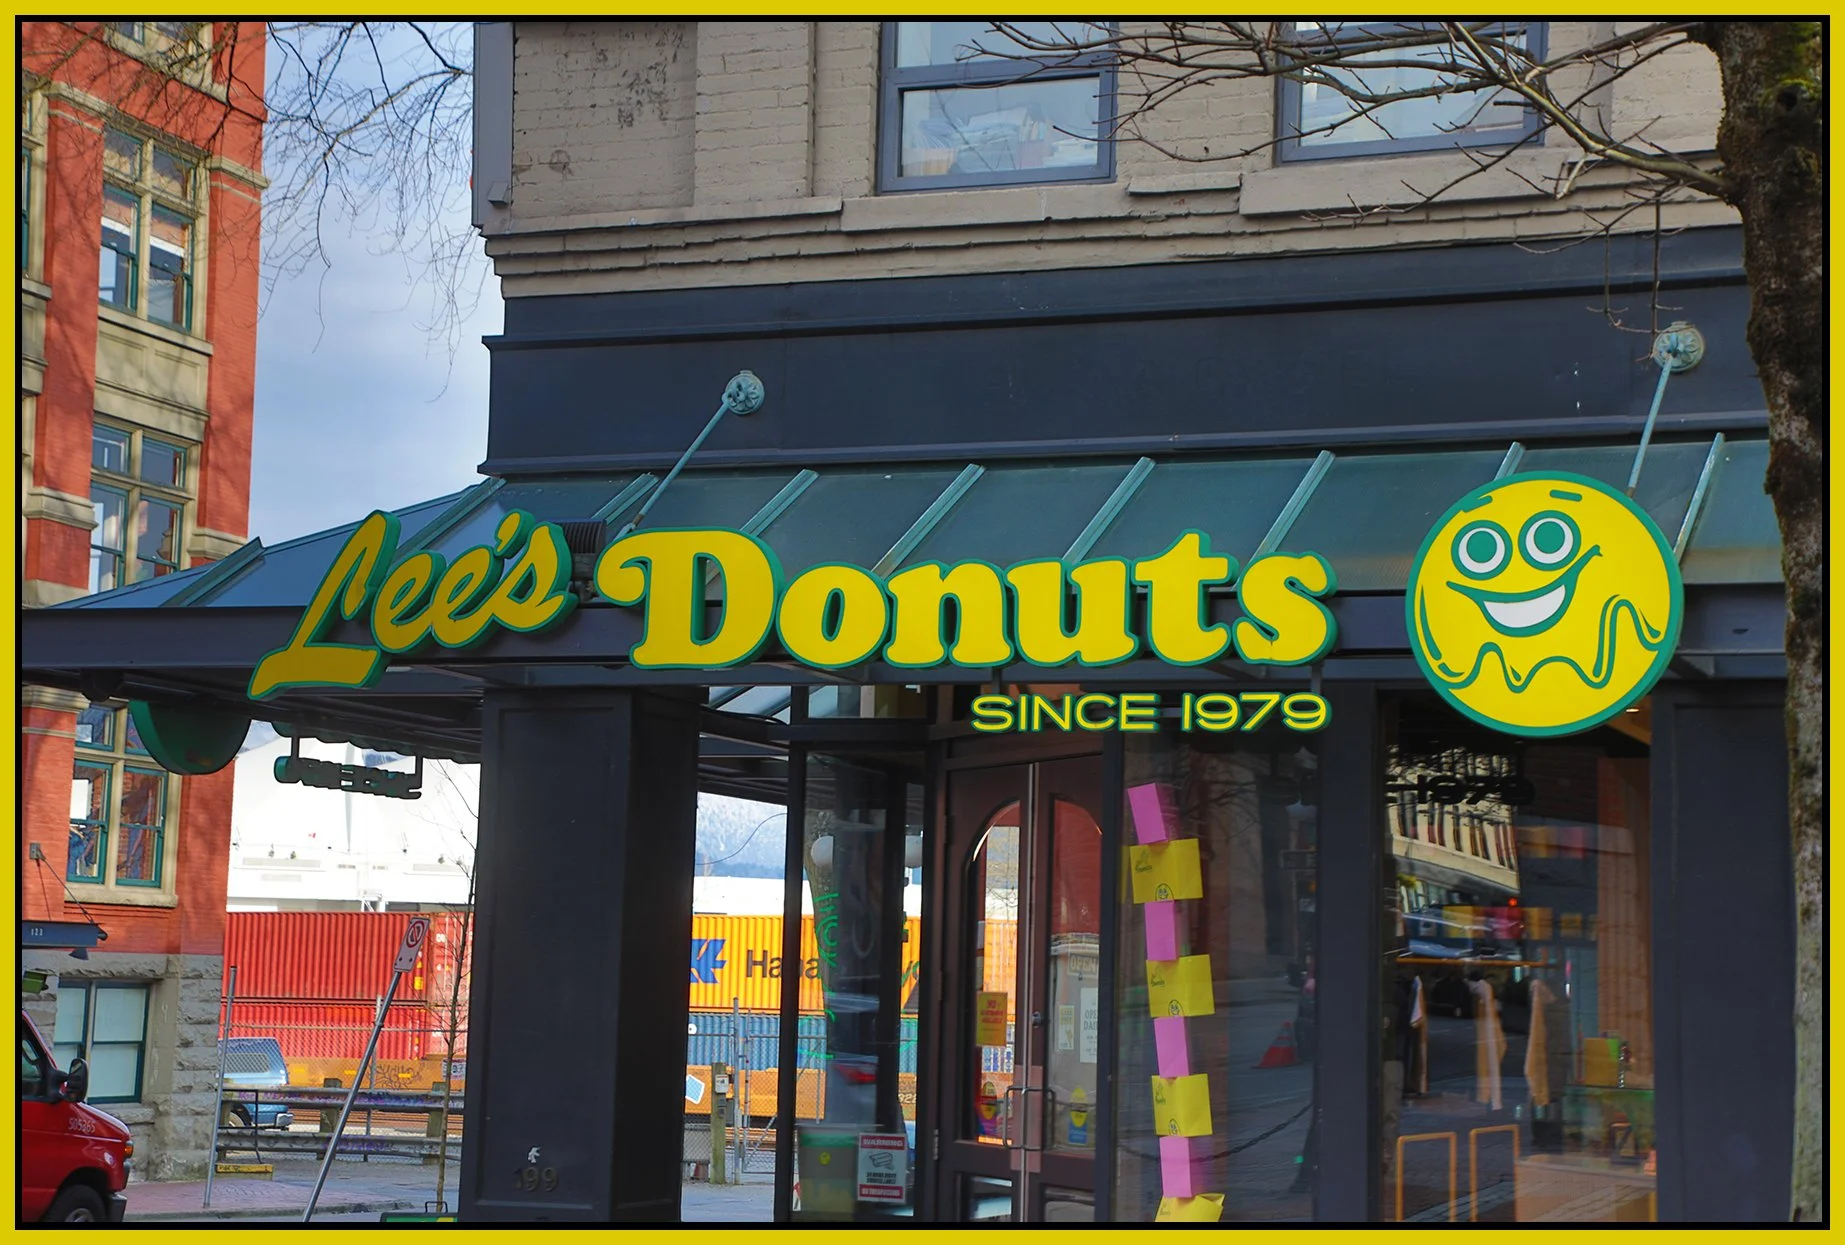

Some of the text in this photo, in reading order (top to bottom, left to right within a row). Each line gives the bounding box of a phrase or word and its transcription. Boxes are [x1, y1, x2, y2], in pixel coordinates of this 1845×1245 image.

[247, 510, 1338, 700] Lee's Donuts
[971, 693, 1331, 732] SINCE 1979
[863, 1138, 903, 1147] WARNING
[513, 1167, 559, 1192] 199
